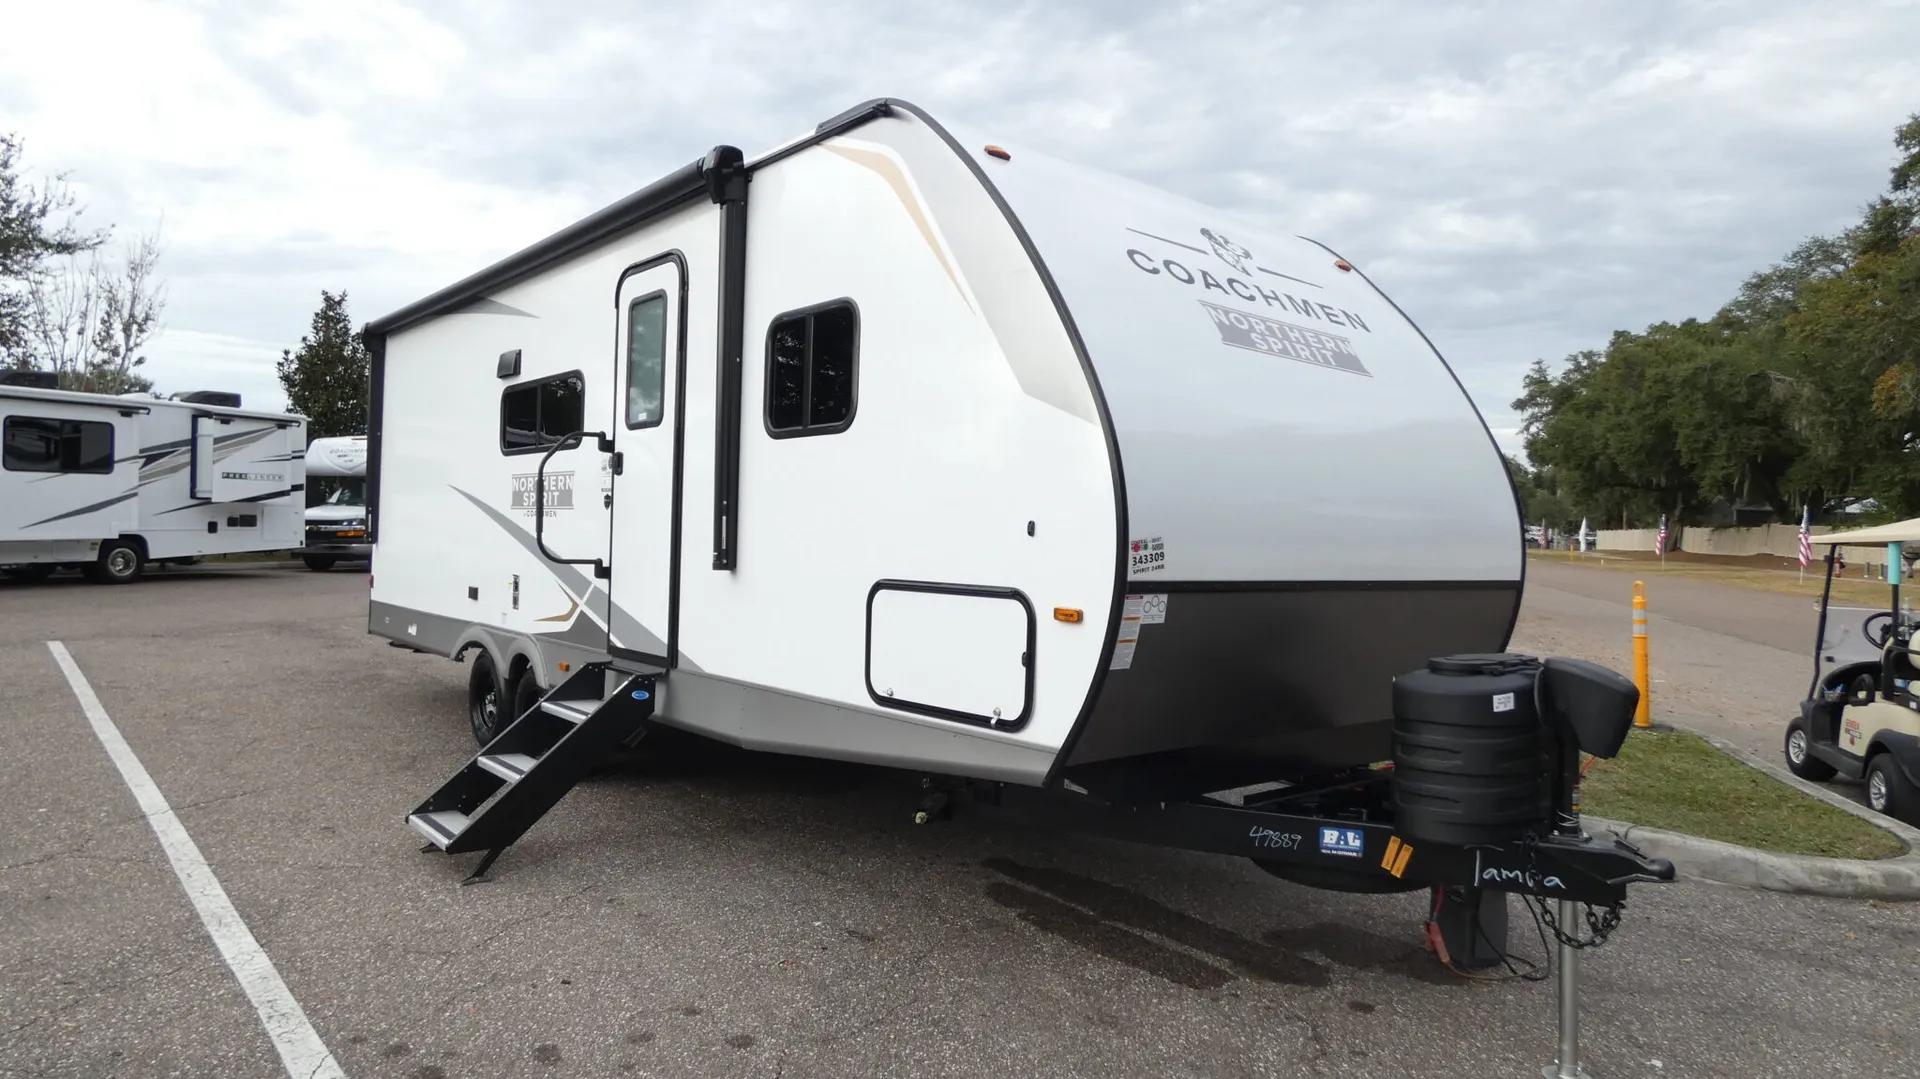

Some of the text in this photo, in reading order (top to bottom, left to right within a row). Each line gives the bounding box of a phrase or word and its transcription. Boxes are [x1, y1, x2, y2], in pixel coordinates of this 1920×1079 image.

[1127, 249, 1372, 333] COACHMEN
[1207, 306, 1356, 357] NORTHERN
[1250, 332, 1337, 366] SPIRIT
[523, 491, 560, 506] SPRIT
[1132, 551, 1165, 567] 343309
[1250, 825, 1302, 850] 49889
